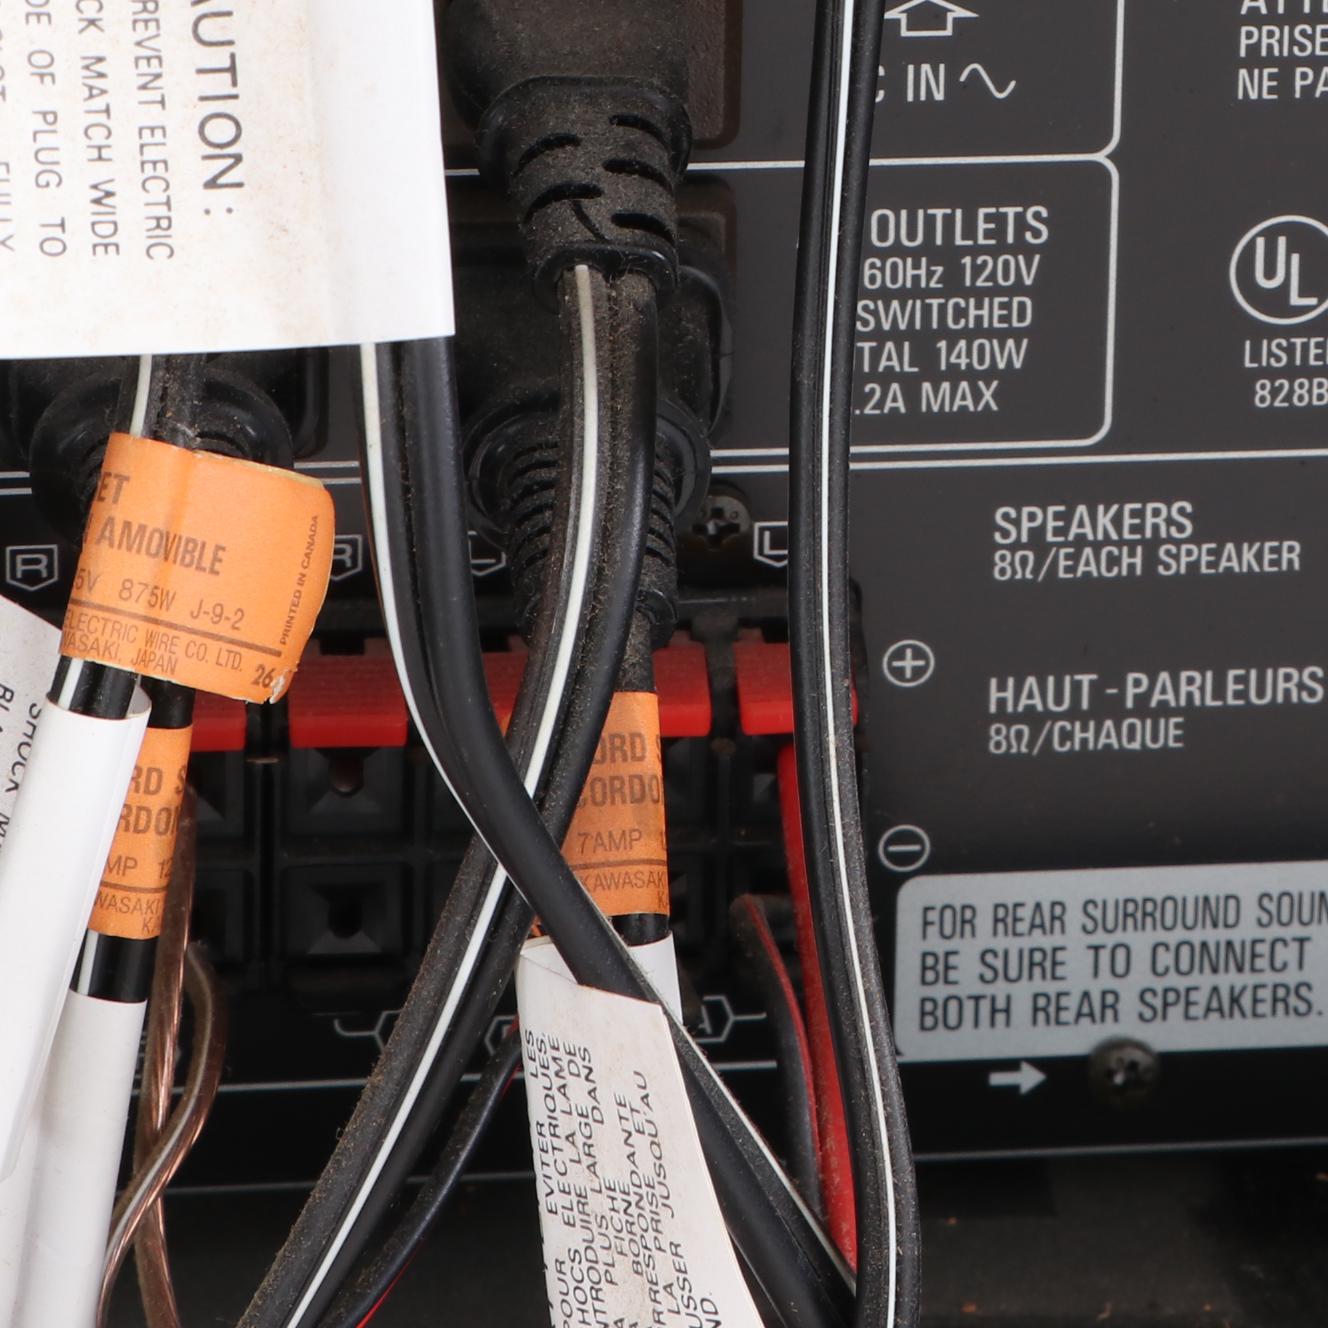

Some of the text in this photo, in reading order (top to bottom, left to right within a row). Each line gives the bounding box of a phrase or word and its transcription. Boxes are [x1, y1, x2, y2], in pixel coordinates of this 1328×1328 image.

[27, 49, 56, 85] OF
[1238, 68, 1278, 99] NE
[81, 56, 112, 162] MATCH
[33, 110, 63, 189] PLUG
[138, 125, 174, 259] ELECTRIC
[39, 217, 67, 257] TO
[89, 179, 120, 256] WIDE
[871, 206, 1048, 247] OUTLETS
[864, 254, 1040, 289] 60Hz 120V
[854, 297, 1032, 331] SWITCHED
[937, 339, 1028, 370] 140W
[922, 380, 998, 412] MAX
[1255, 378, 1328, 407] 828B
[994, 501, 1192, 544] SPEAKERS
[97, 515, 226, 576] AMOVIBLE
[994, 541, 1300, 581] 8Ω/EACH SPEAKER
[119, 578, 245, 631] 875W J-9-2
[989, 717, 1183, 754] 8Ω/CHAQUE
[922, 904, 976, 940] FOR
[993, 901, 1066, 937] REAR
[1082, 895, 1240, 935] SURROUND
[921, 937, 1310, 986] BE SURE TO CONNECT
[920, 982, 1322, 1031] BOTH REAR SPEAKERS.
[578, 1046, 604, 1125] DANS
[525, 1029, 559, 1215] EVITER LES
[576, 1104, 602, 1195] LARGE
